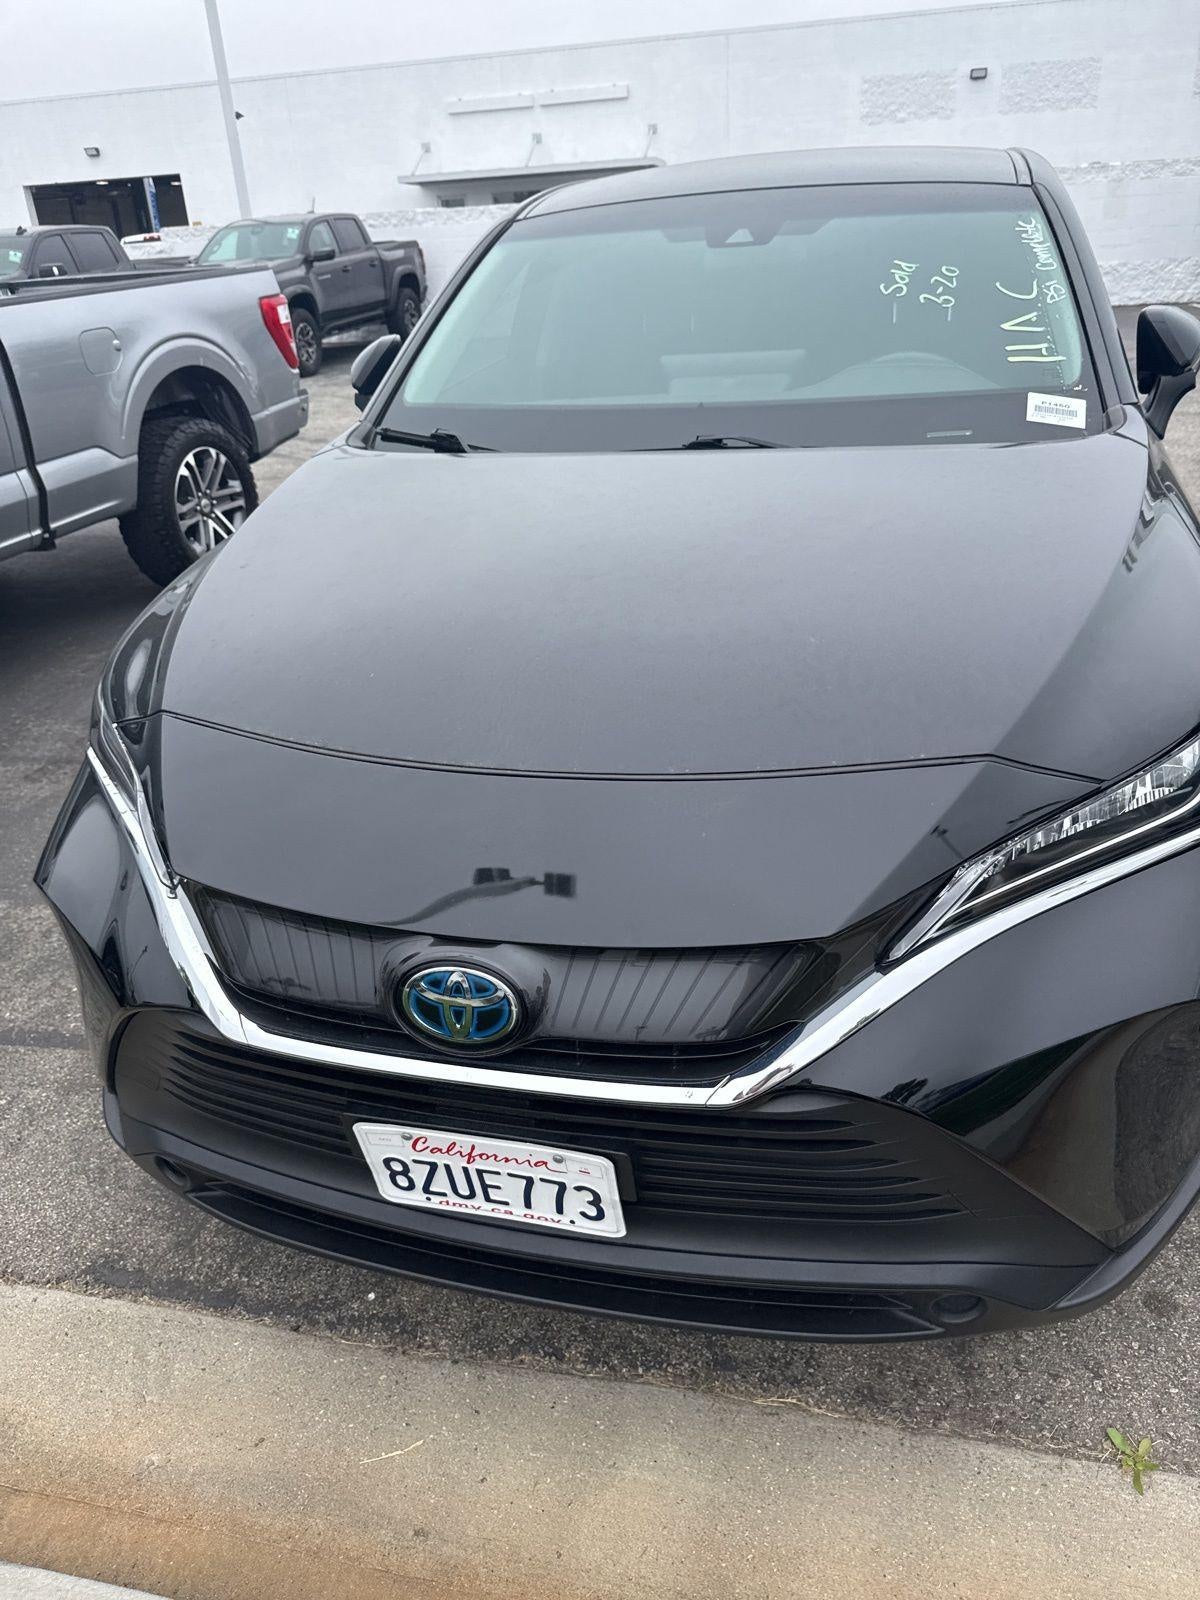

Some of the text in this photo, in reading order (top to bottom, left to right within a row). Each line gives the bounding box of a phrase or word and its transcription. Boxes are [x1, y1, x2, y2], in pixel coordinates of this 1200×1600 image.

[880, 260, 919, 297] Sold
[411, 1136, 567, 1174] California
[382, 1156, 605, 1222] 8ZUE773
